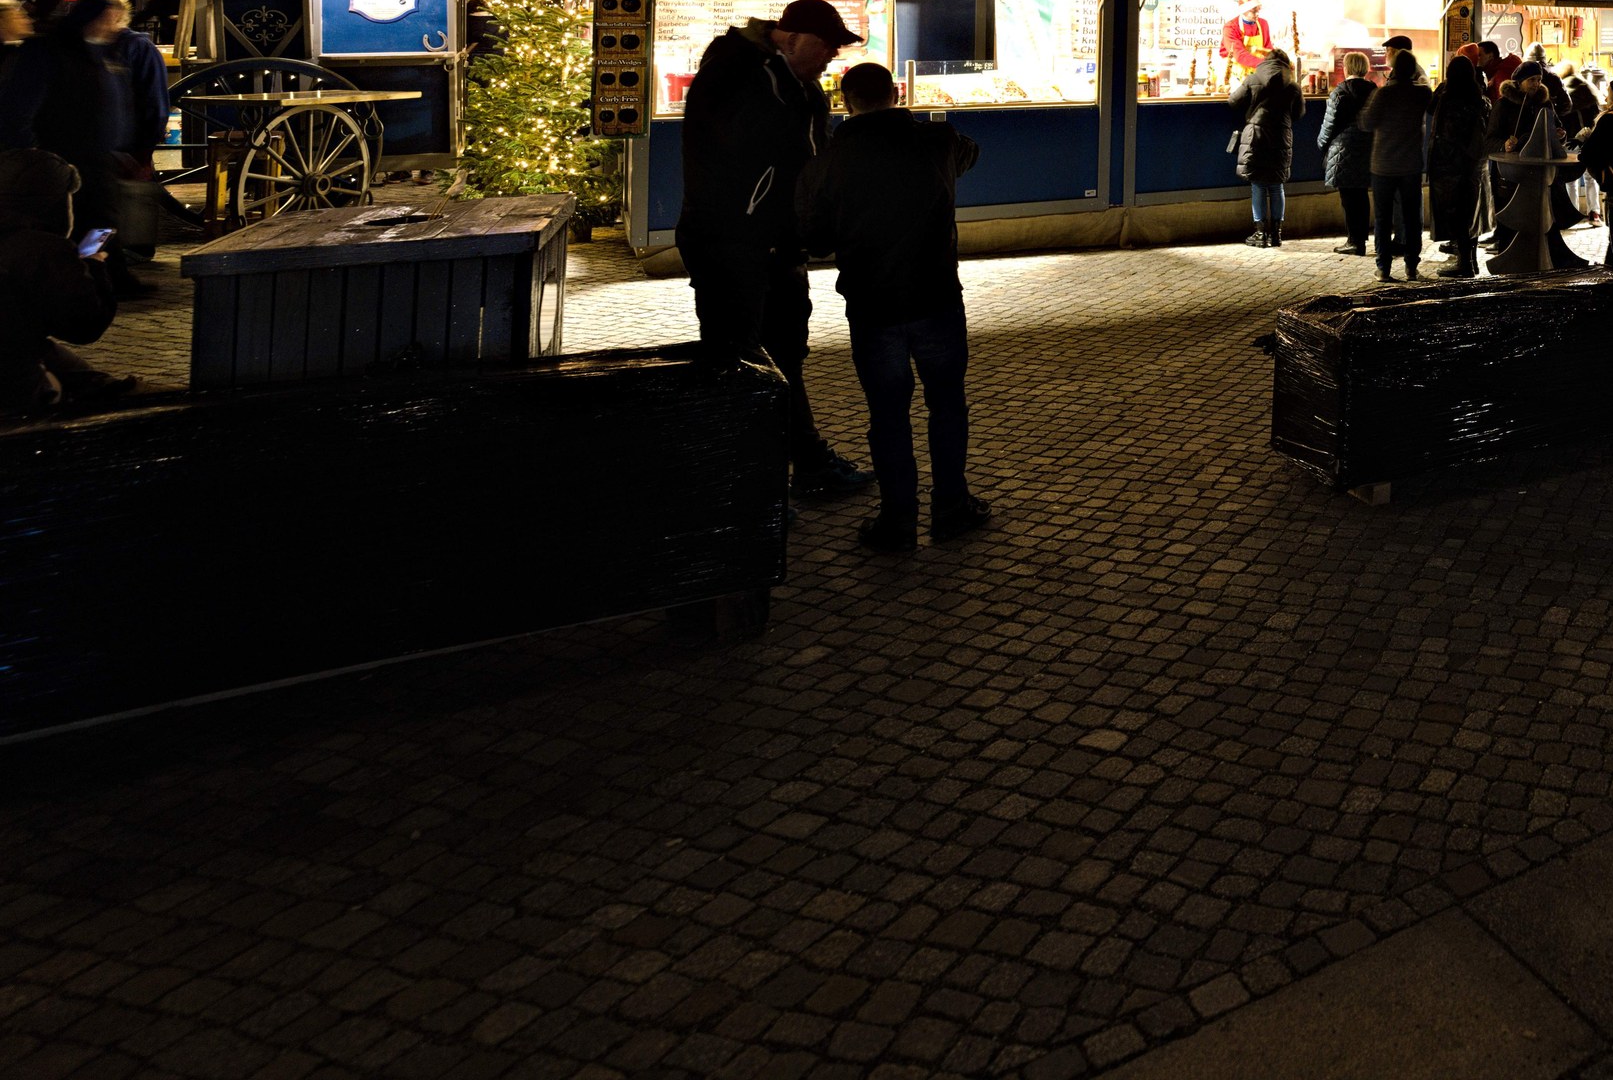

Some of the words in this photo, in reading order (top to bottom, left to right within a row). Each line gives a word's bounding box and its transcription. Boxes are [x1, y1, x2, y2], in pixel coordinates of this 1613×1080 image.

[1174, 27, 1196, 35] Sour
[1199, 27, 1222, 35] Crea
[1174, 37, 1219, 46] Chilisoße
